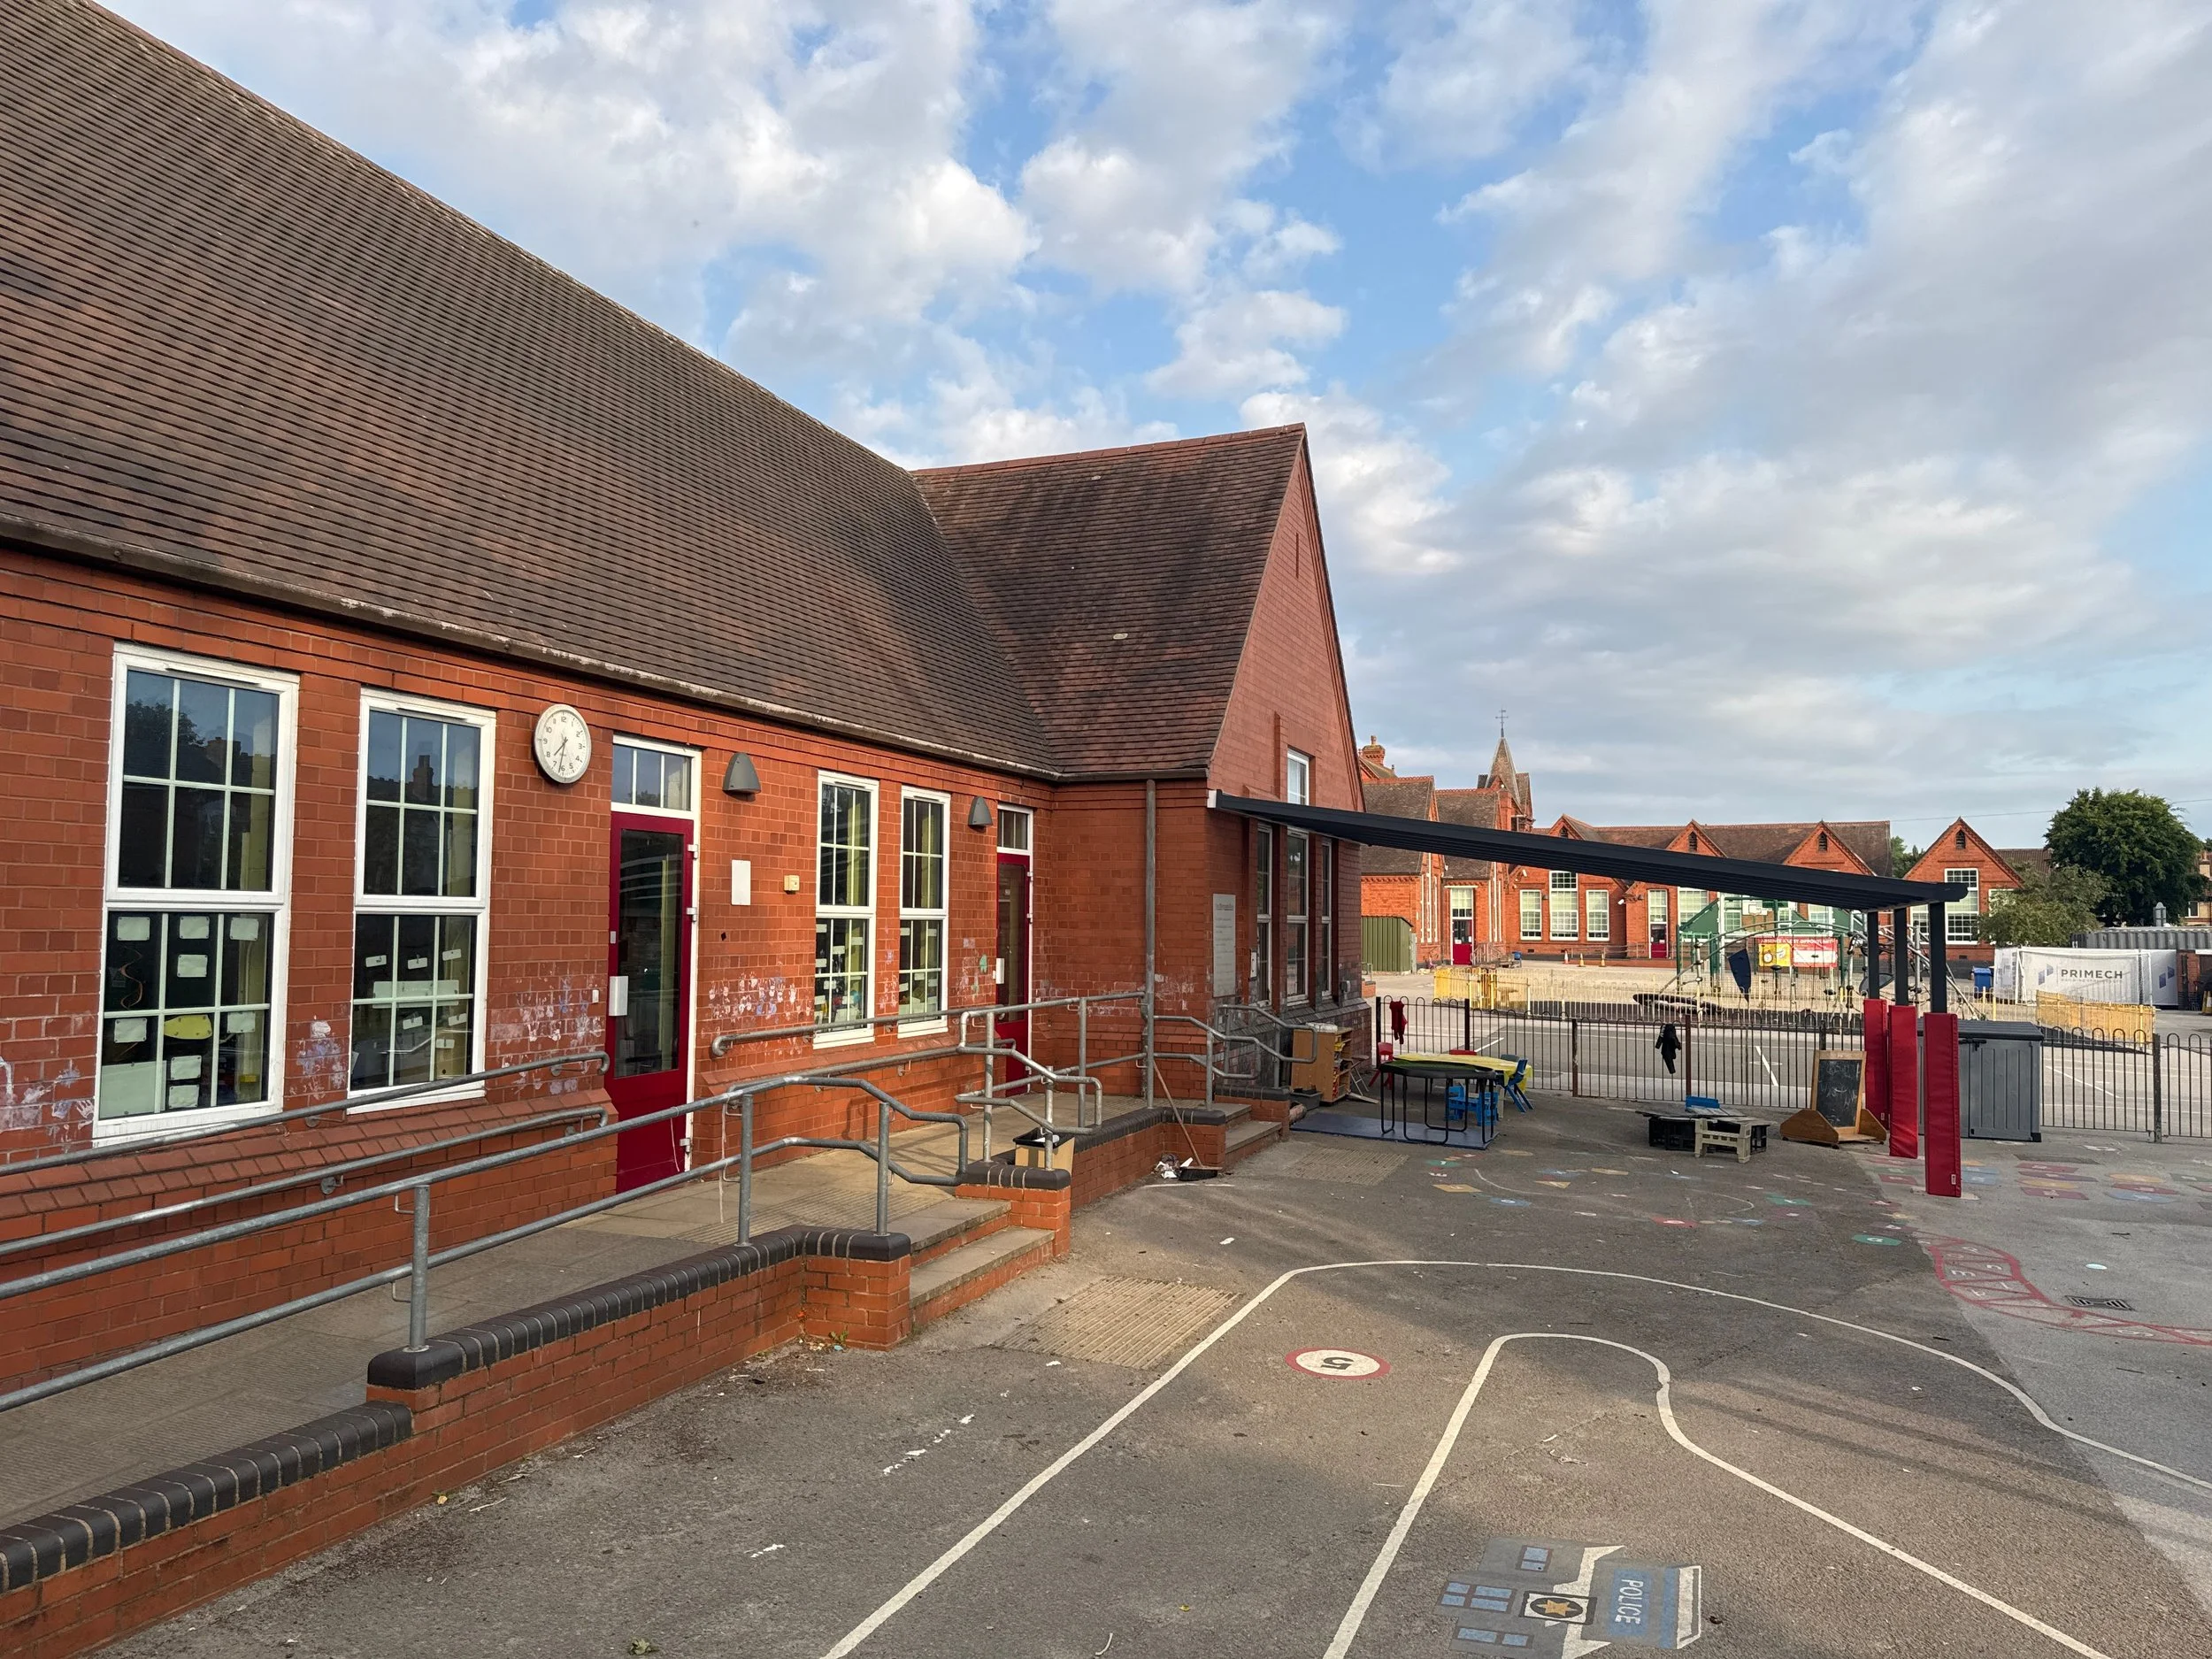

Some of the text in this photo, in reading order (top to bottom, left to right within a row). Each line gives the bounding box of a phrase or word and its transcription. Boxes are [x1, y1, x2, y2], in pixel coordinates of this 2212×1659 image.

[2061, 969, 2123, 979] PRIMECH
[1320, 1356, 1355, 1370] 5
[1615, 1578, 1644, 1624] POLICE
